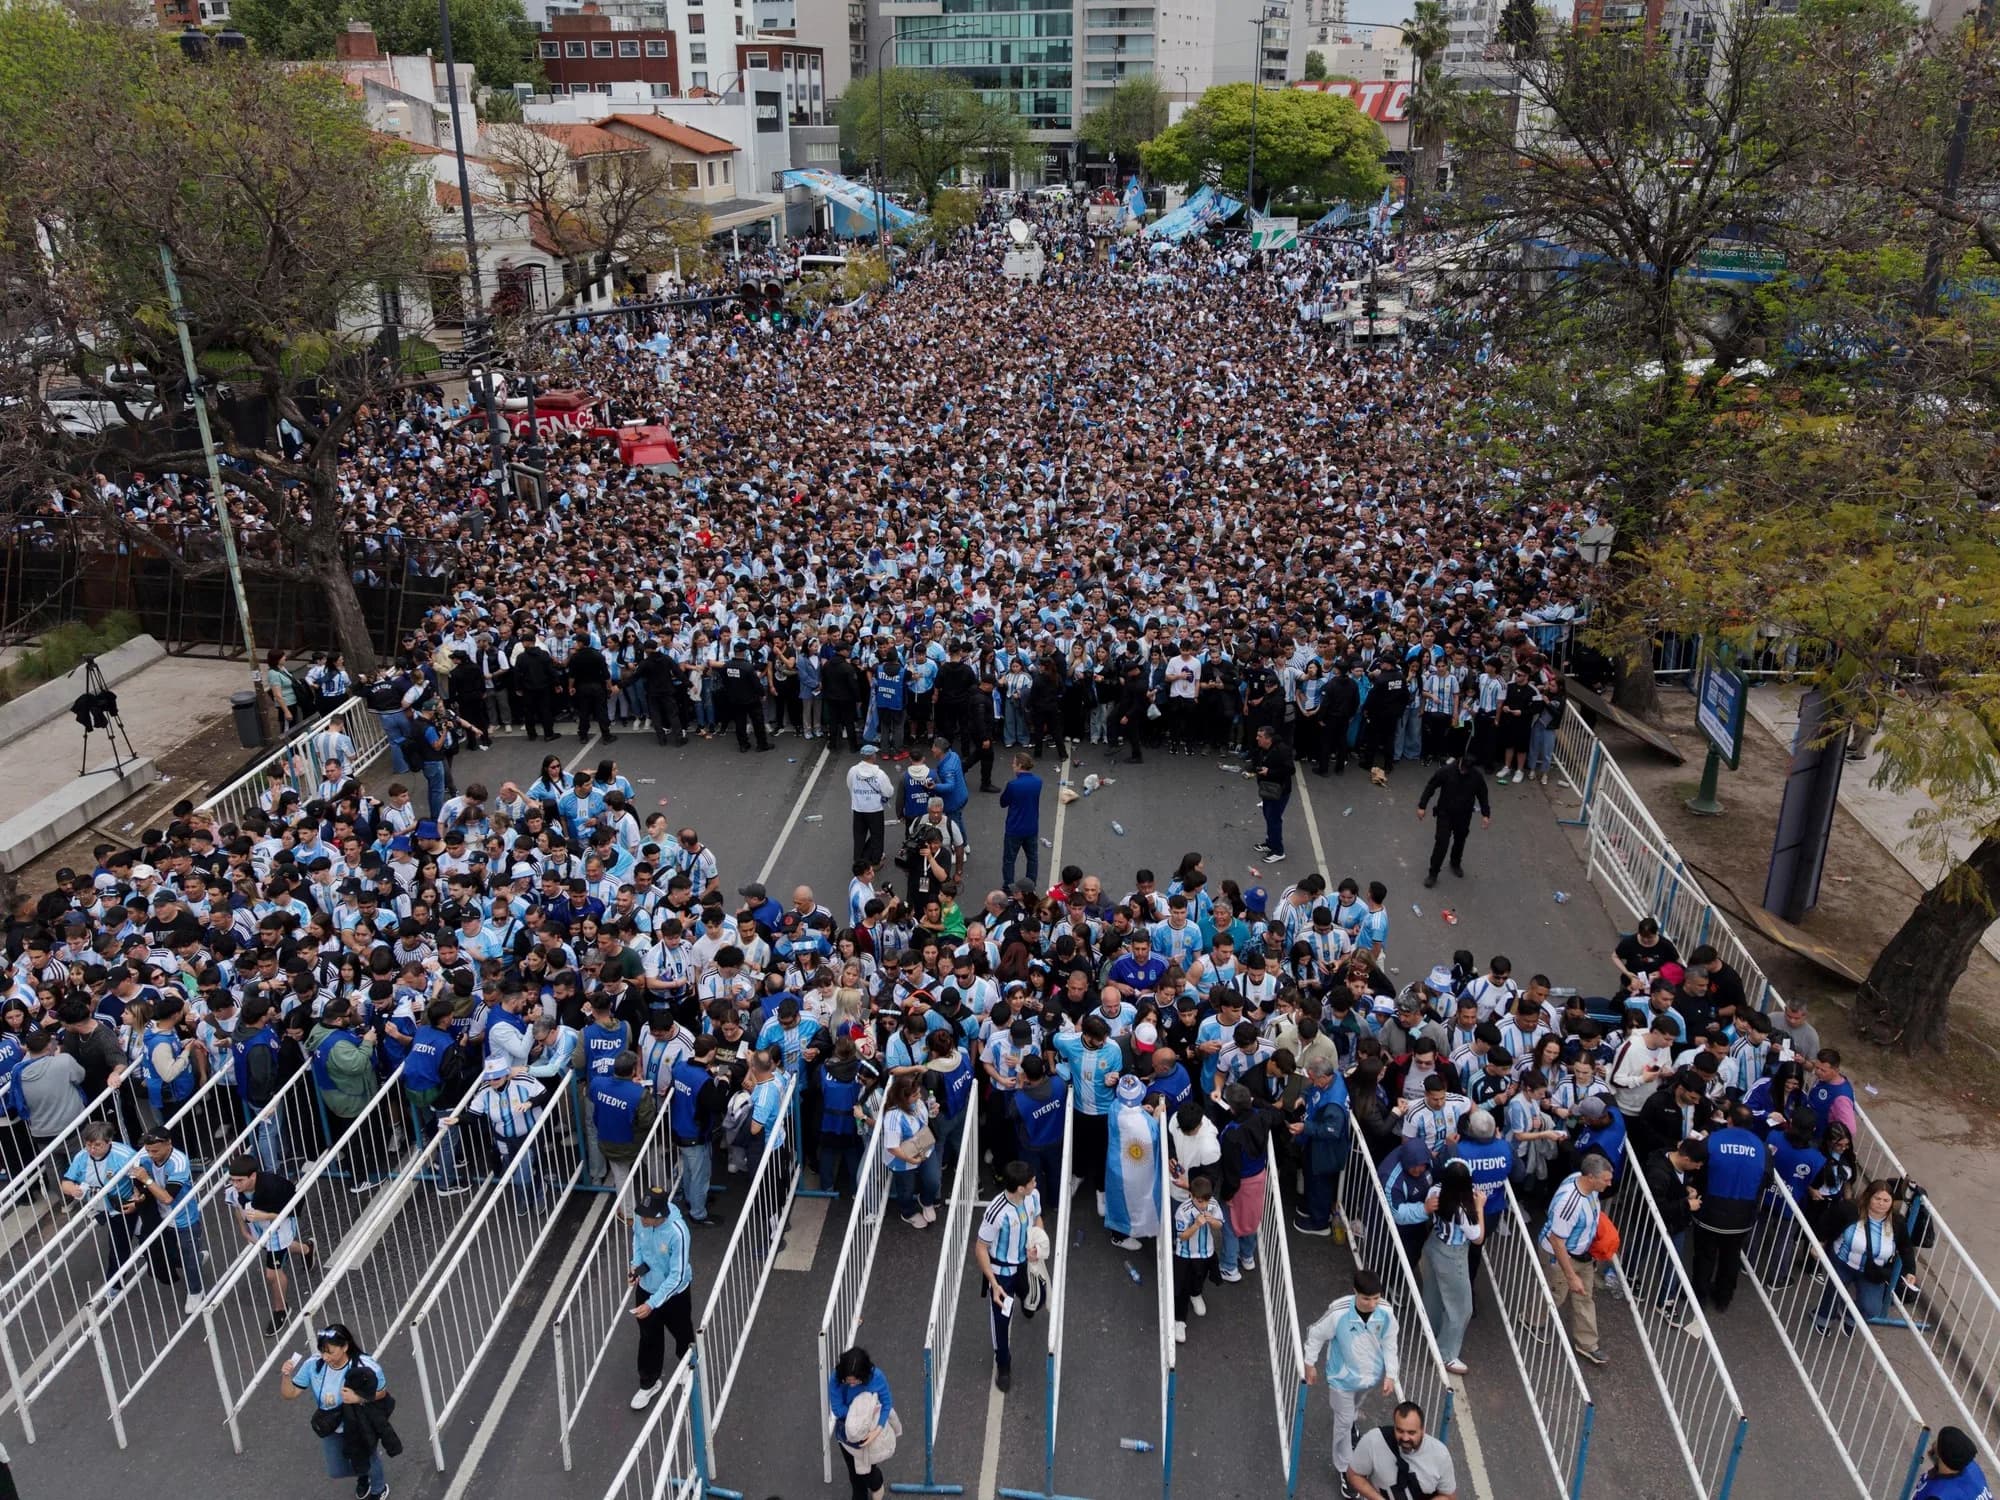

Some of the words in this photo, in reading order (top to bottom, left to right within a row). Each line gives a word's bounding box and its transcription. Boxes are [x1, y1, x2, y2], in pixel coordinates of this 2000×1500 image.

[450, 1017, 471, 1027] UTED
[590, 1038, 622, 1050] UTEDYC
[0, 1045, 14, 1063] DYC
[597, 1091, 628, 1110] UTEDYC
[1032, 1099, 1061, 1120] UTEDYC
[1720, 1143, 1756, 1158] UTEDYC
[1468, 1156, 1506, 1171] UTEDYC
